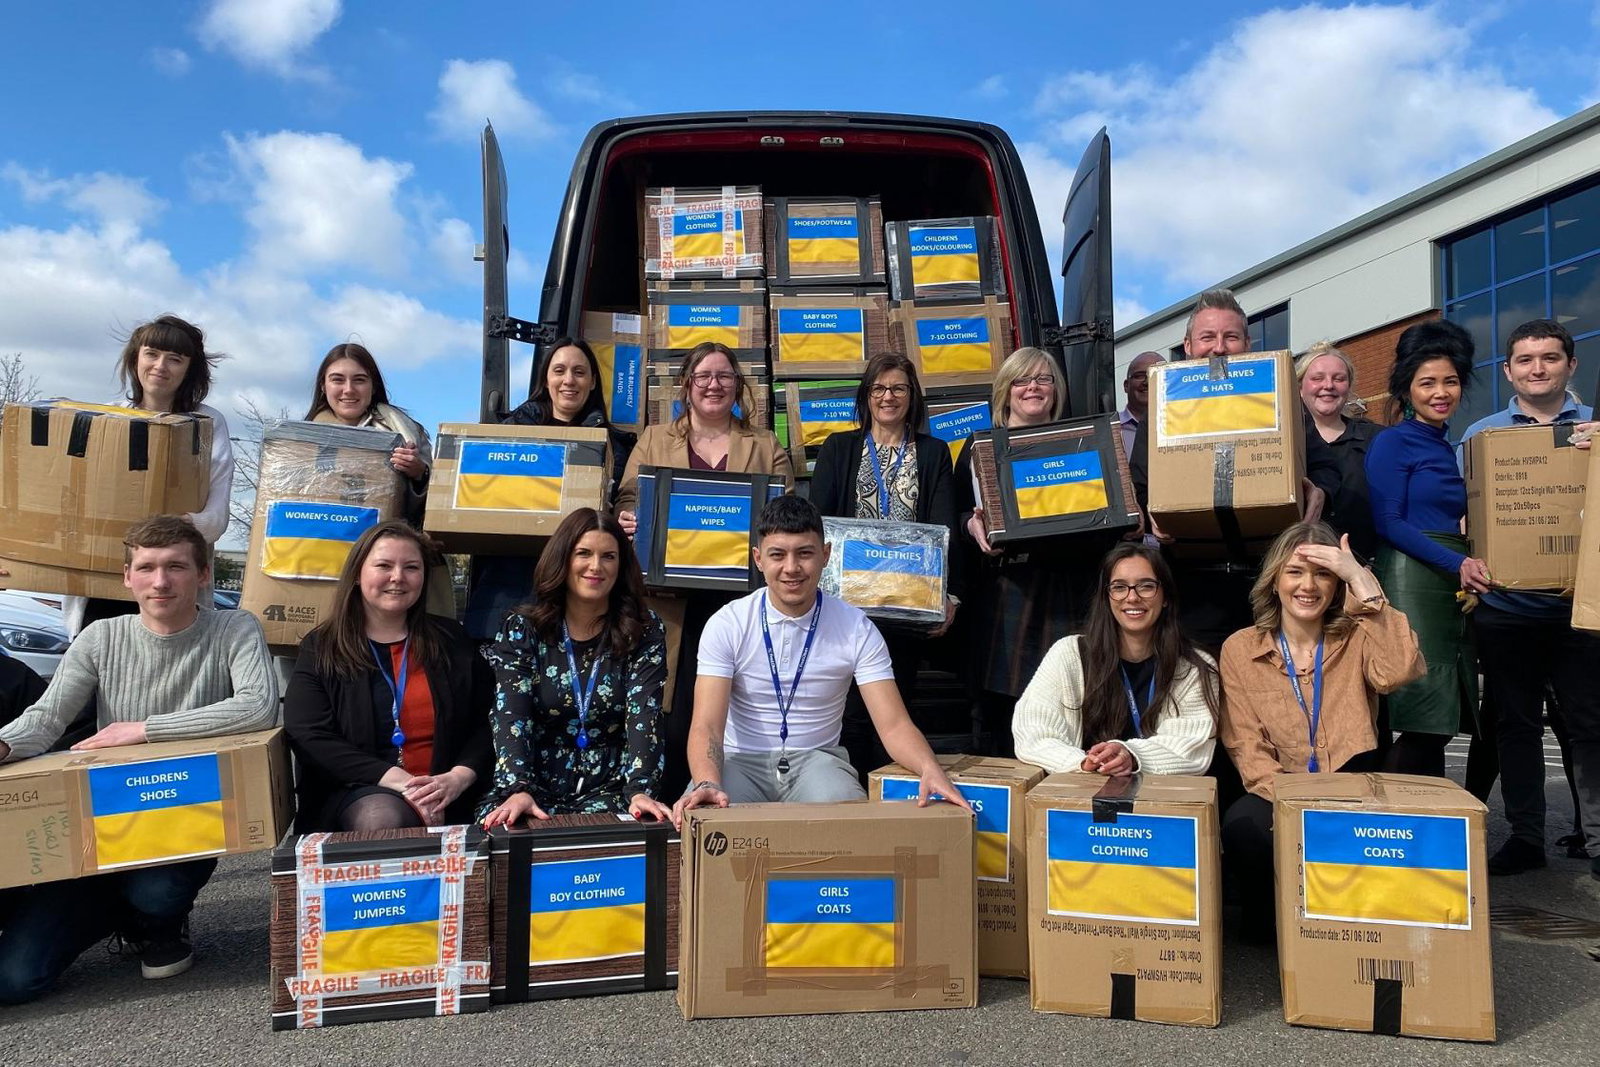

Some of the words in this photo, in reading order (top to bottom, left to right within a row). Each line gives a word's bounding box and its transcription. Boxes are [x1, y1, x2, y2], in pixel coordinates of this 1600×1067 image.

[685, 213, 716, 221] WOMENS
[794, 219, 852, 227] SHOES/FOOTWEAR
[685, 222, 717, 230] CLOTHING
[911, 243, 973, 252] BOOKS/COLOURING
[946, 332, 978, 340] CLOTHING
[1182, 372, 1210, 383] GLOVE
[1228, 369, 1254, 378] ARVES
[1211, 383, 1234, 391] HATS
[935, 421, 953, 430] GIRLS
[954, 413, 983, 426] JUMPERS
[953, 427, 971, 437] 12-13
[488, 452, 517, 463] FIRST
[519, 452, 539, 463] AID
[1043, 460, 1065, 469] GIRLS
[1025, 474, 1046, 483] 12-13
[1047, 469, 1087, 481] CLOTHING
[685, 504, 742, 515] NAPPIES/BABY
[330, 513, 359, 524] COATS
[700, 518, 725, 527] WIPES
[865, 548, 921, 561] TOILETRIES
[295, 606, 316, 614] ACES
[126, 771, 189, 787] CHILDRENS
[22, 790, 39, 803] G4
[140, 788, 177, 802] SHOES
[1354, 827, 1413, 841] WOMENS
[705, 832, 728, 856] hp
[733, 838, 751, 849] E24
[755, 837, 769, 849] G4
[1092, 845, 1149, 858] CLOTHING
[1364, 847, 1405, 859] COATS
[313, 864, 381, 884] FRAGILE
[402, 857, 467, 876] FRAGILE
[574, 873, 601, 885] BABY
[352, 888, 406, 903] WOMENS
[550, 892, 572, 903] BOY
[574, 887, 625, 902] CLOTHING
[820, 887, 849, 897] GIRLS
[353, 905, 406, 920] JUMPERS
[817, 904, 851, 914] COATS
[1140, 925, 1157, 940] Single
[1300, 927, 1327, 940] Production
[1159, 950, 1175, 961] 8877
[291, 976, 359, 995] FRAGILE
[380, 968, 445, 988] FRAGILE
